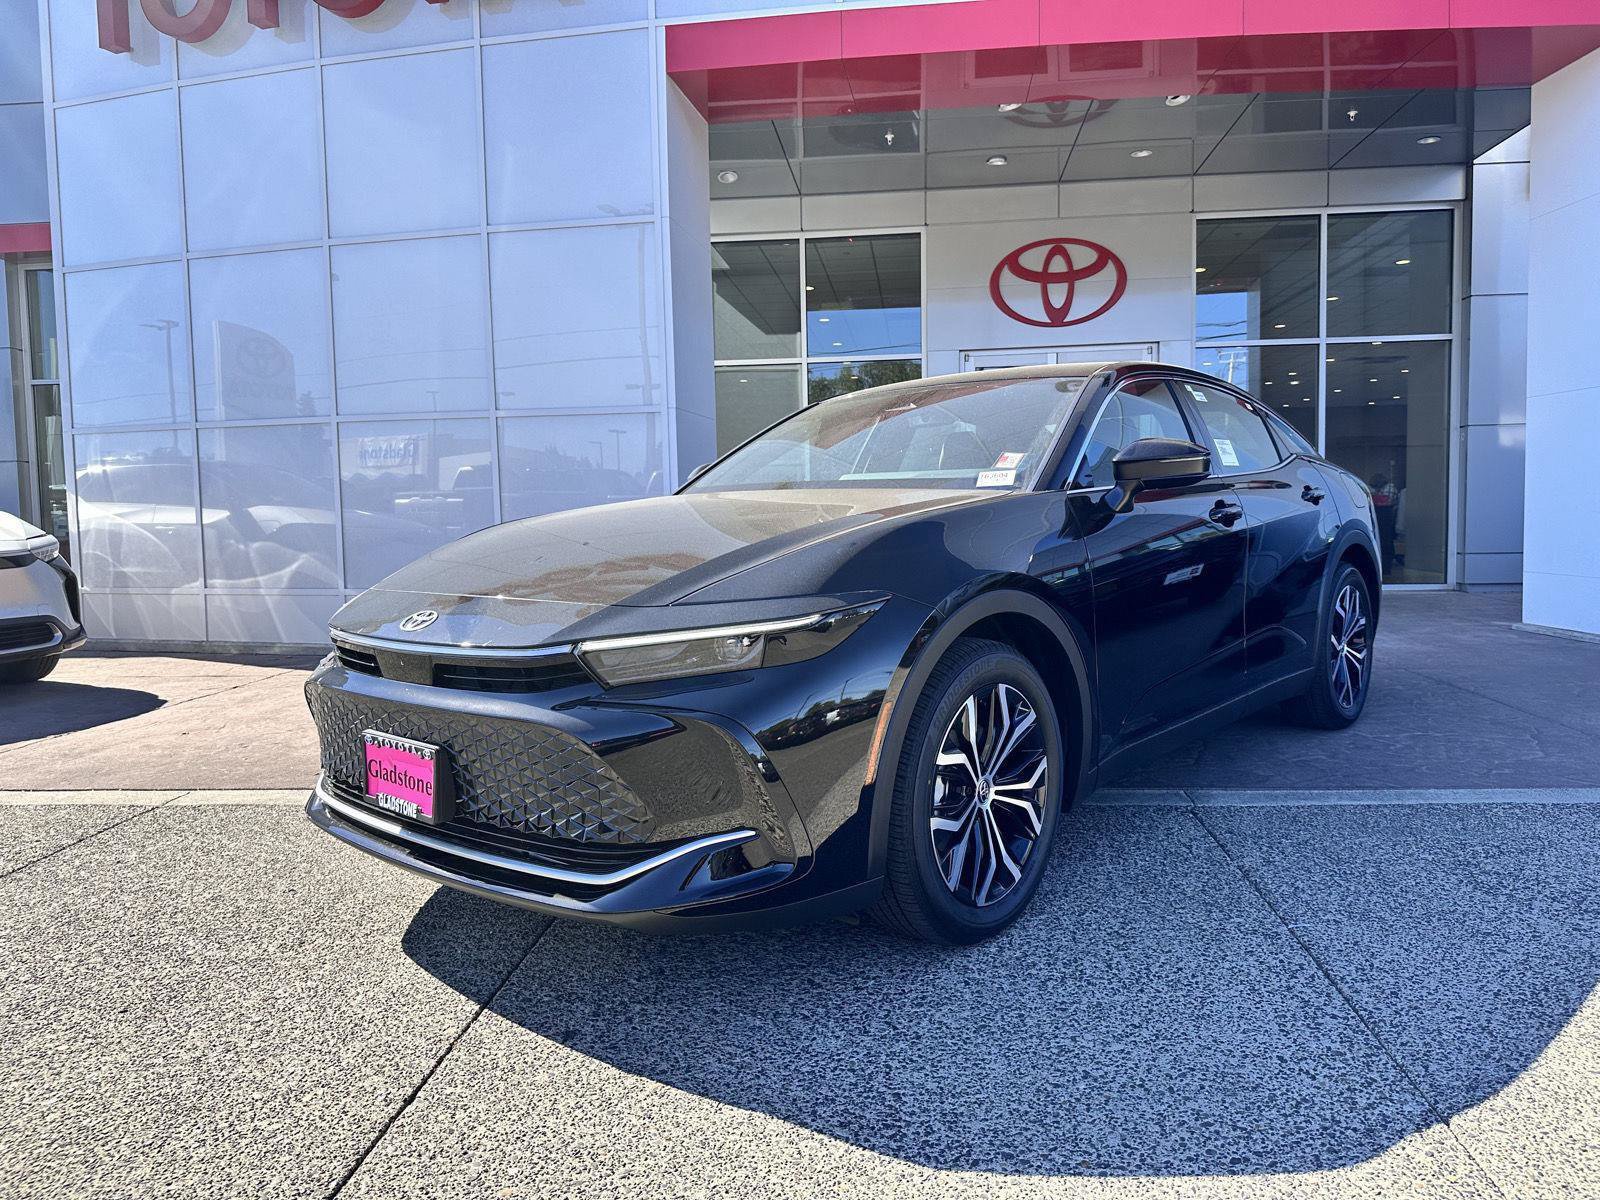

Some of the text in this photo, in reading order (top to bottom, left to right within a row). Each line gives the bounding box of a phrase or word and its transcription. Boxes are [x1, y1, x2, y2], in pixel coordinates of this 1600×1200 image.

[378, 737, 416, 755] TOYOTA
[367, 759, 433, 796] Gladstone
[378, 793, 418, 818] GLADSTONE
